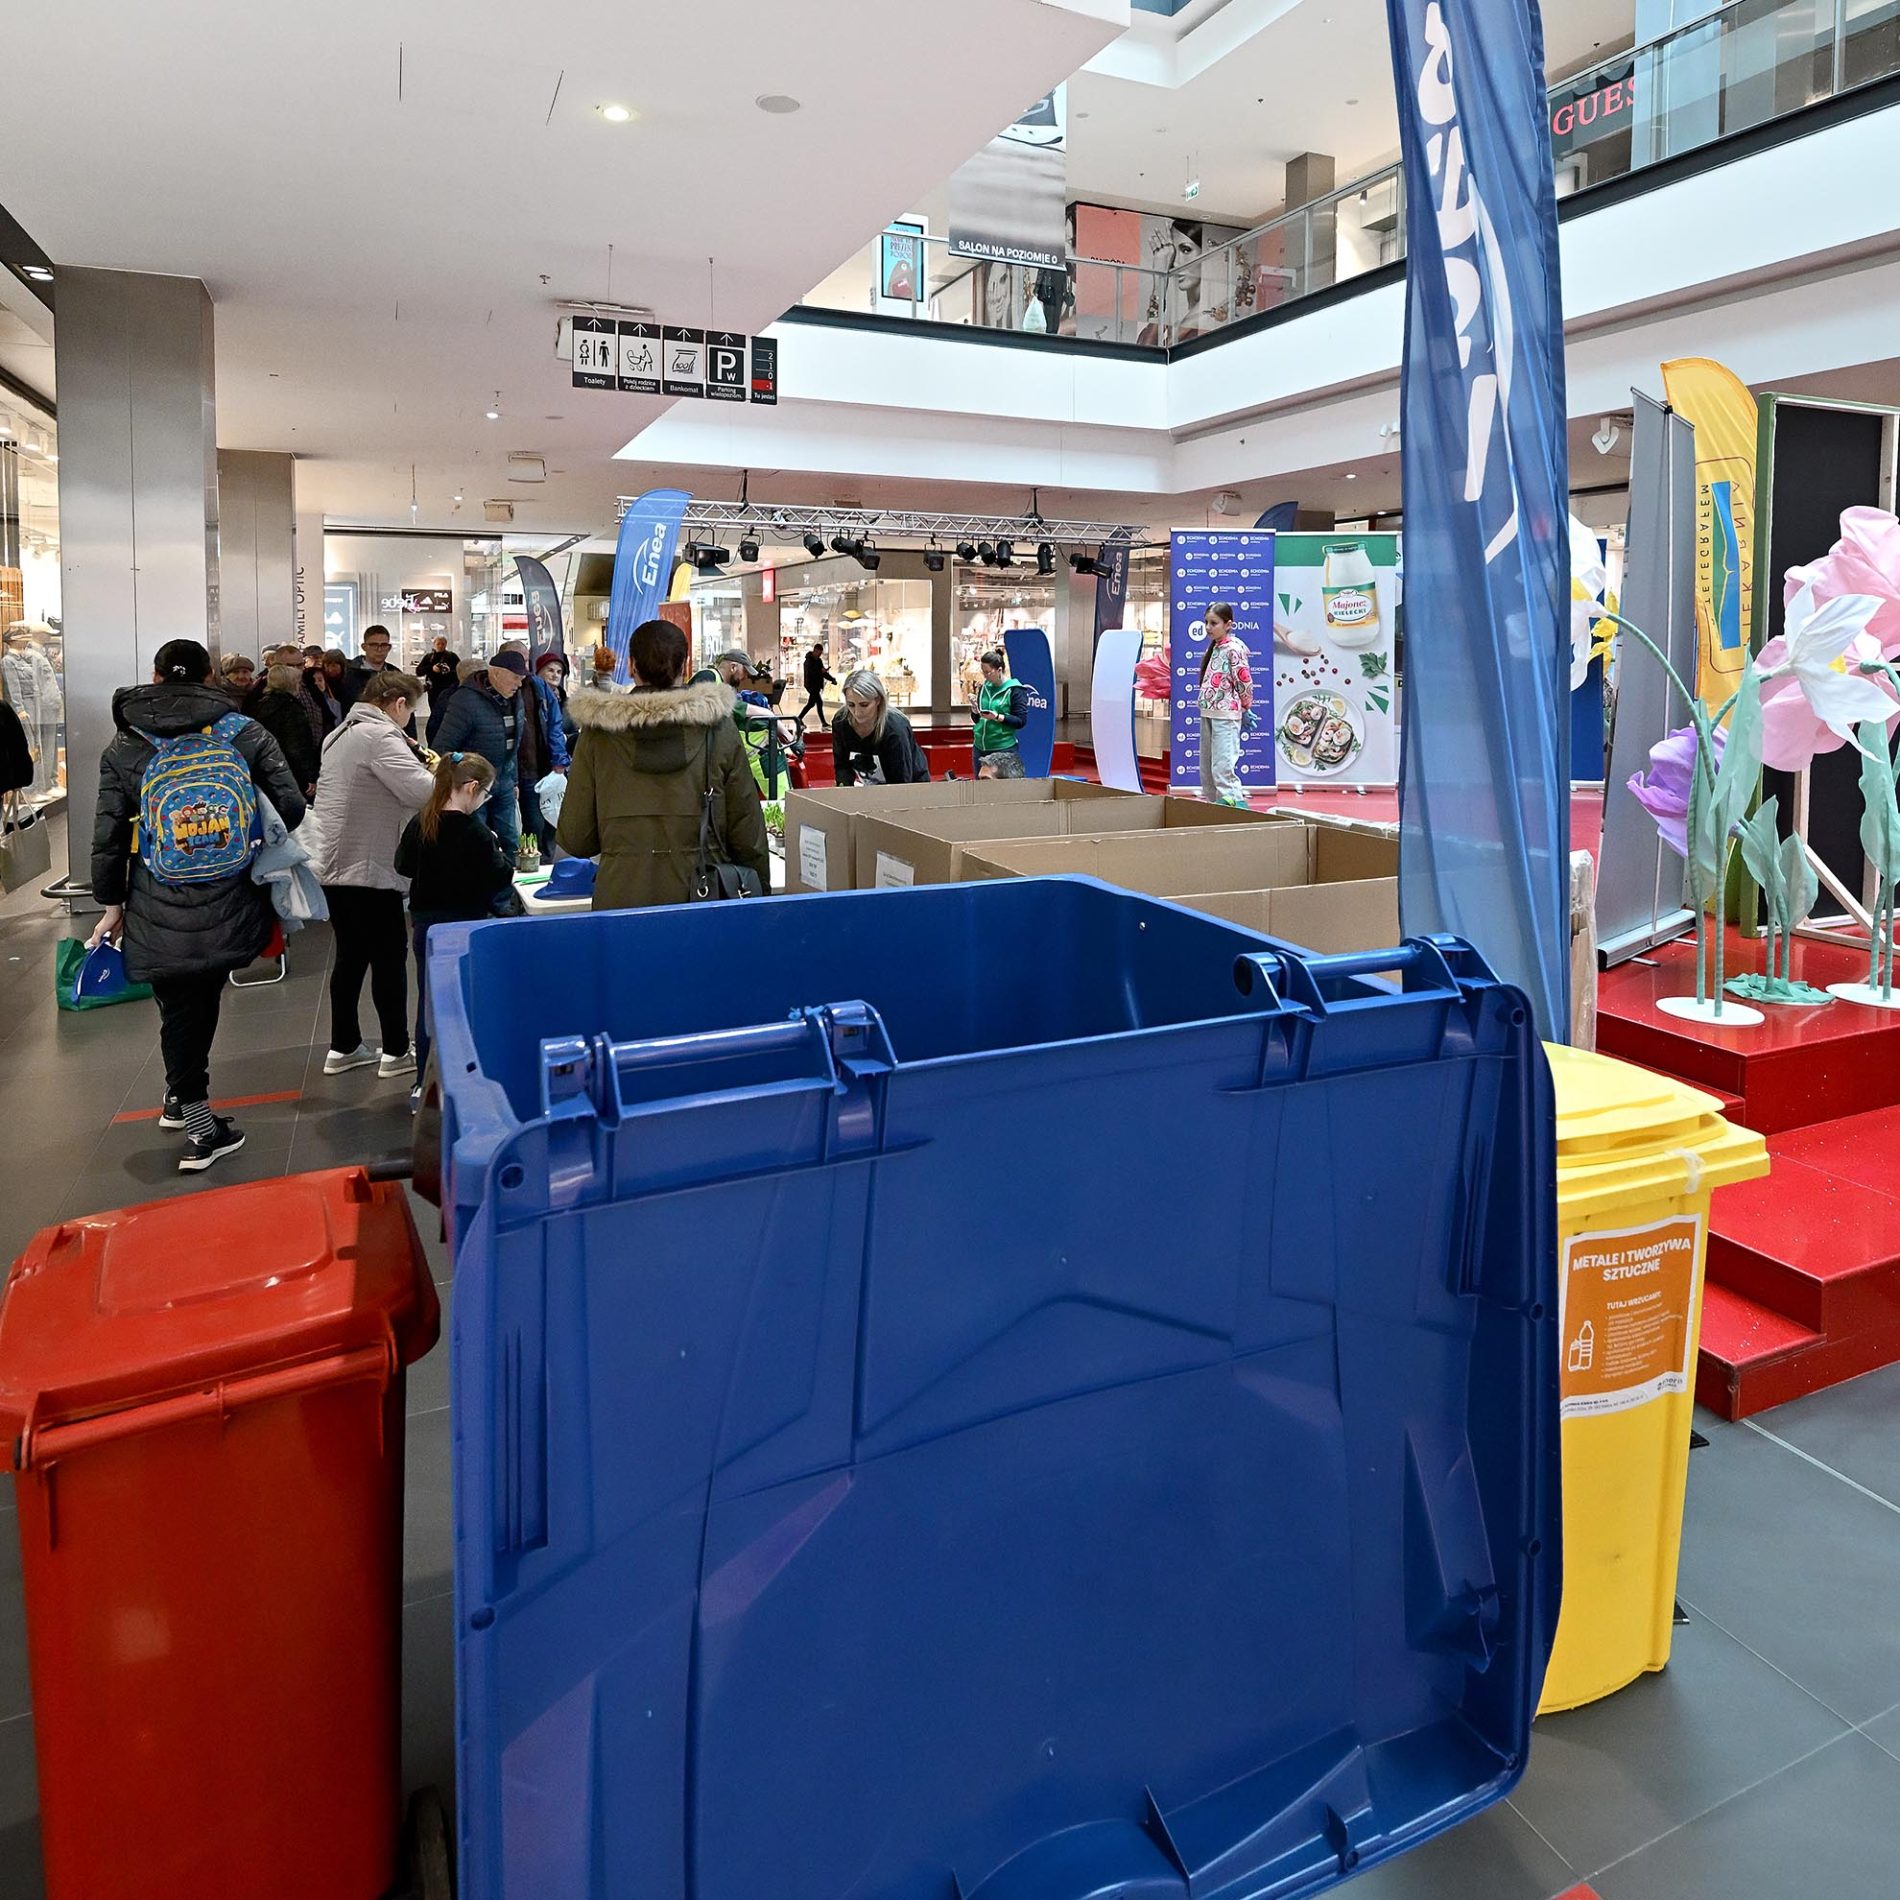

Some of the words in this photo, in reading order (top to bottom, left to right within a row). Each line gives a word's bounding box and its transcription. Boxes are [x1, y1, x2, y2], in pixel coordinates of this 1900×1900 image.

[958, 240, 990, 254] SALON
[991, 245, 1005, 256] NA
[1006, 247, 1050, 264] POZIOMIE
[768, 352, 774, 360] 2
[583, 376, 606, 386] Toalety
[768, 372, 773, 380] 0
[641, 523, 667, 587] Enea
[1111, 551, 1123, 596] Enea
[1192, 624, 1203, 636] ed
[1232, 622, 1259, 630] ODNIA
[1026, 692, 1048, 710] nea
[1572, 1252, 1619, 1271] METALE
[1620, 1252, 1625, 1264] I
[1626, 1238, 1691, 1263] TWORZYWA
[1602, 1258, 1661, 1281] SZTUCZNE
